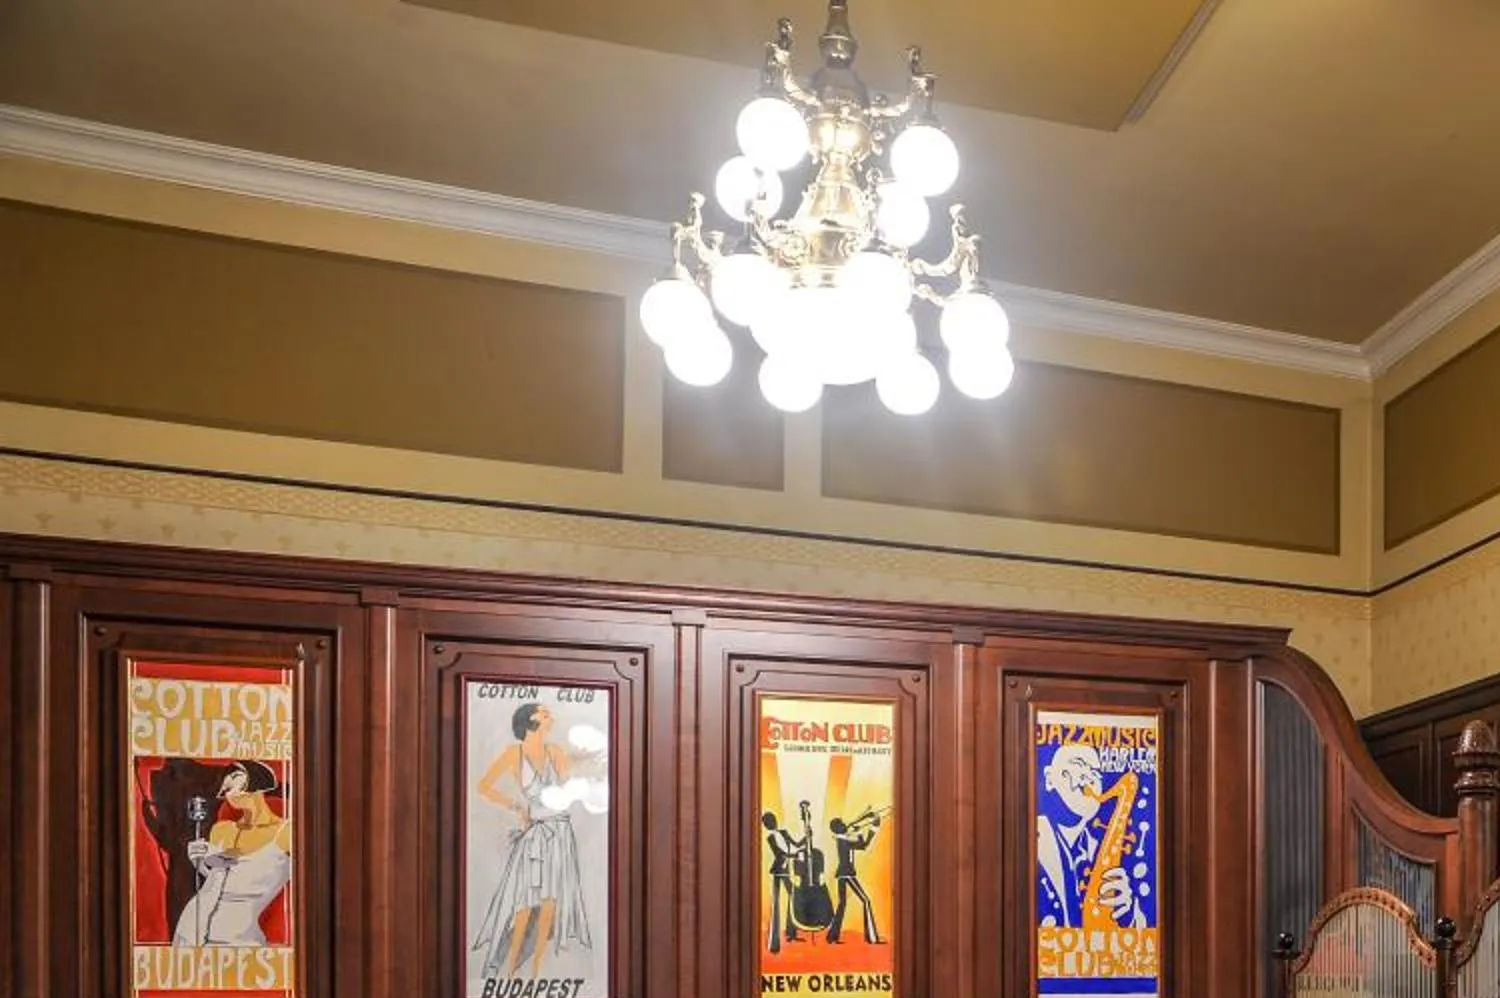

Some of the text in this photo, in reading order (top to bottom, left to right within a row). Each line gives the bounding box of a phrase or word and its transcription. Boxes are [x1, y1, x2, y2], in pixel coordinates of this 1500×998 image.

[132, 677, 292, 721] COTTON
[478, 683, 595, 703] COTTON CLUB
[132, 714, 239, 758] CLUB
[238, 720, 292, 743] JAZZ
[761, 716, 829, 750] COTTON
[832, 723, 891, 744] CLUB
[1037, 723, 1089, 746] JAZZ
[1037, 927, 1157, 955] COTTON
[134, 947, 294, 990] BUDAPEST
[760, 974, 893, 993] NEW ORLEANS
